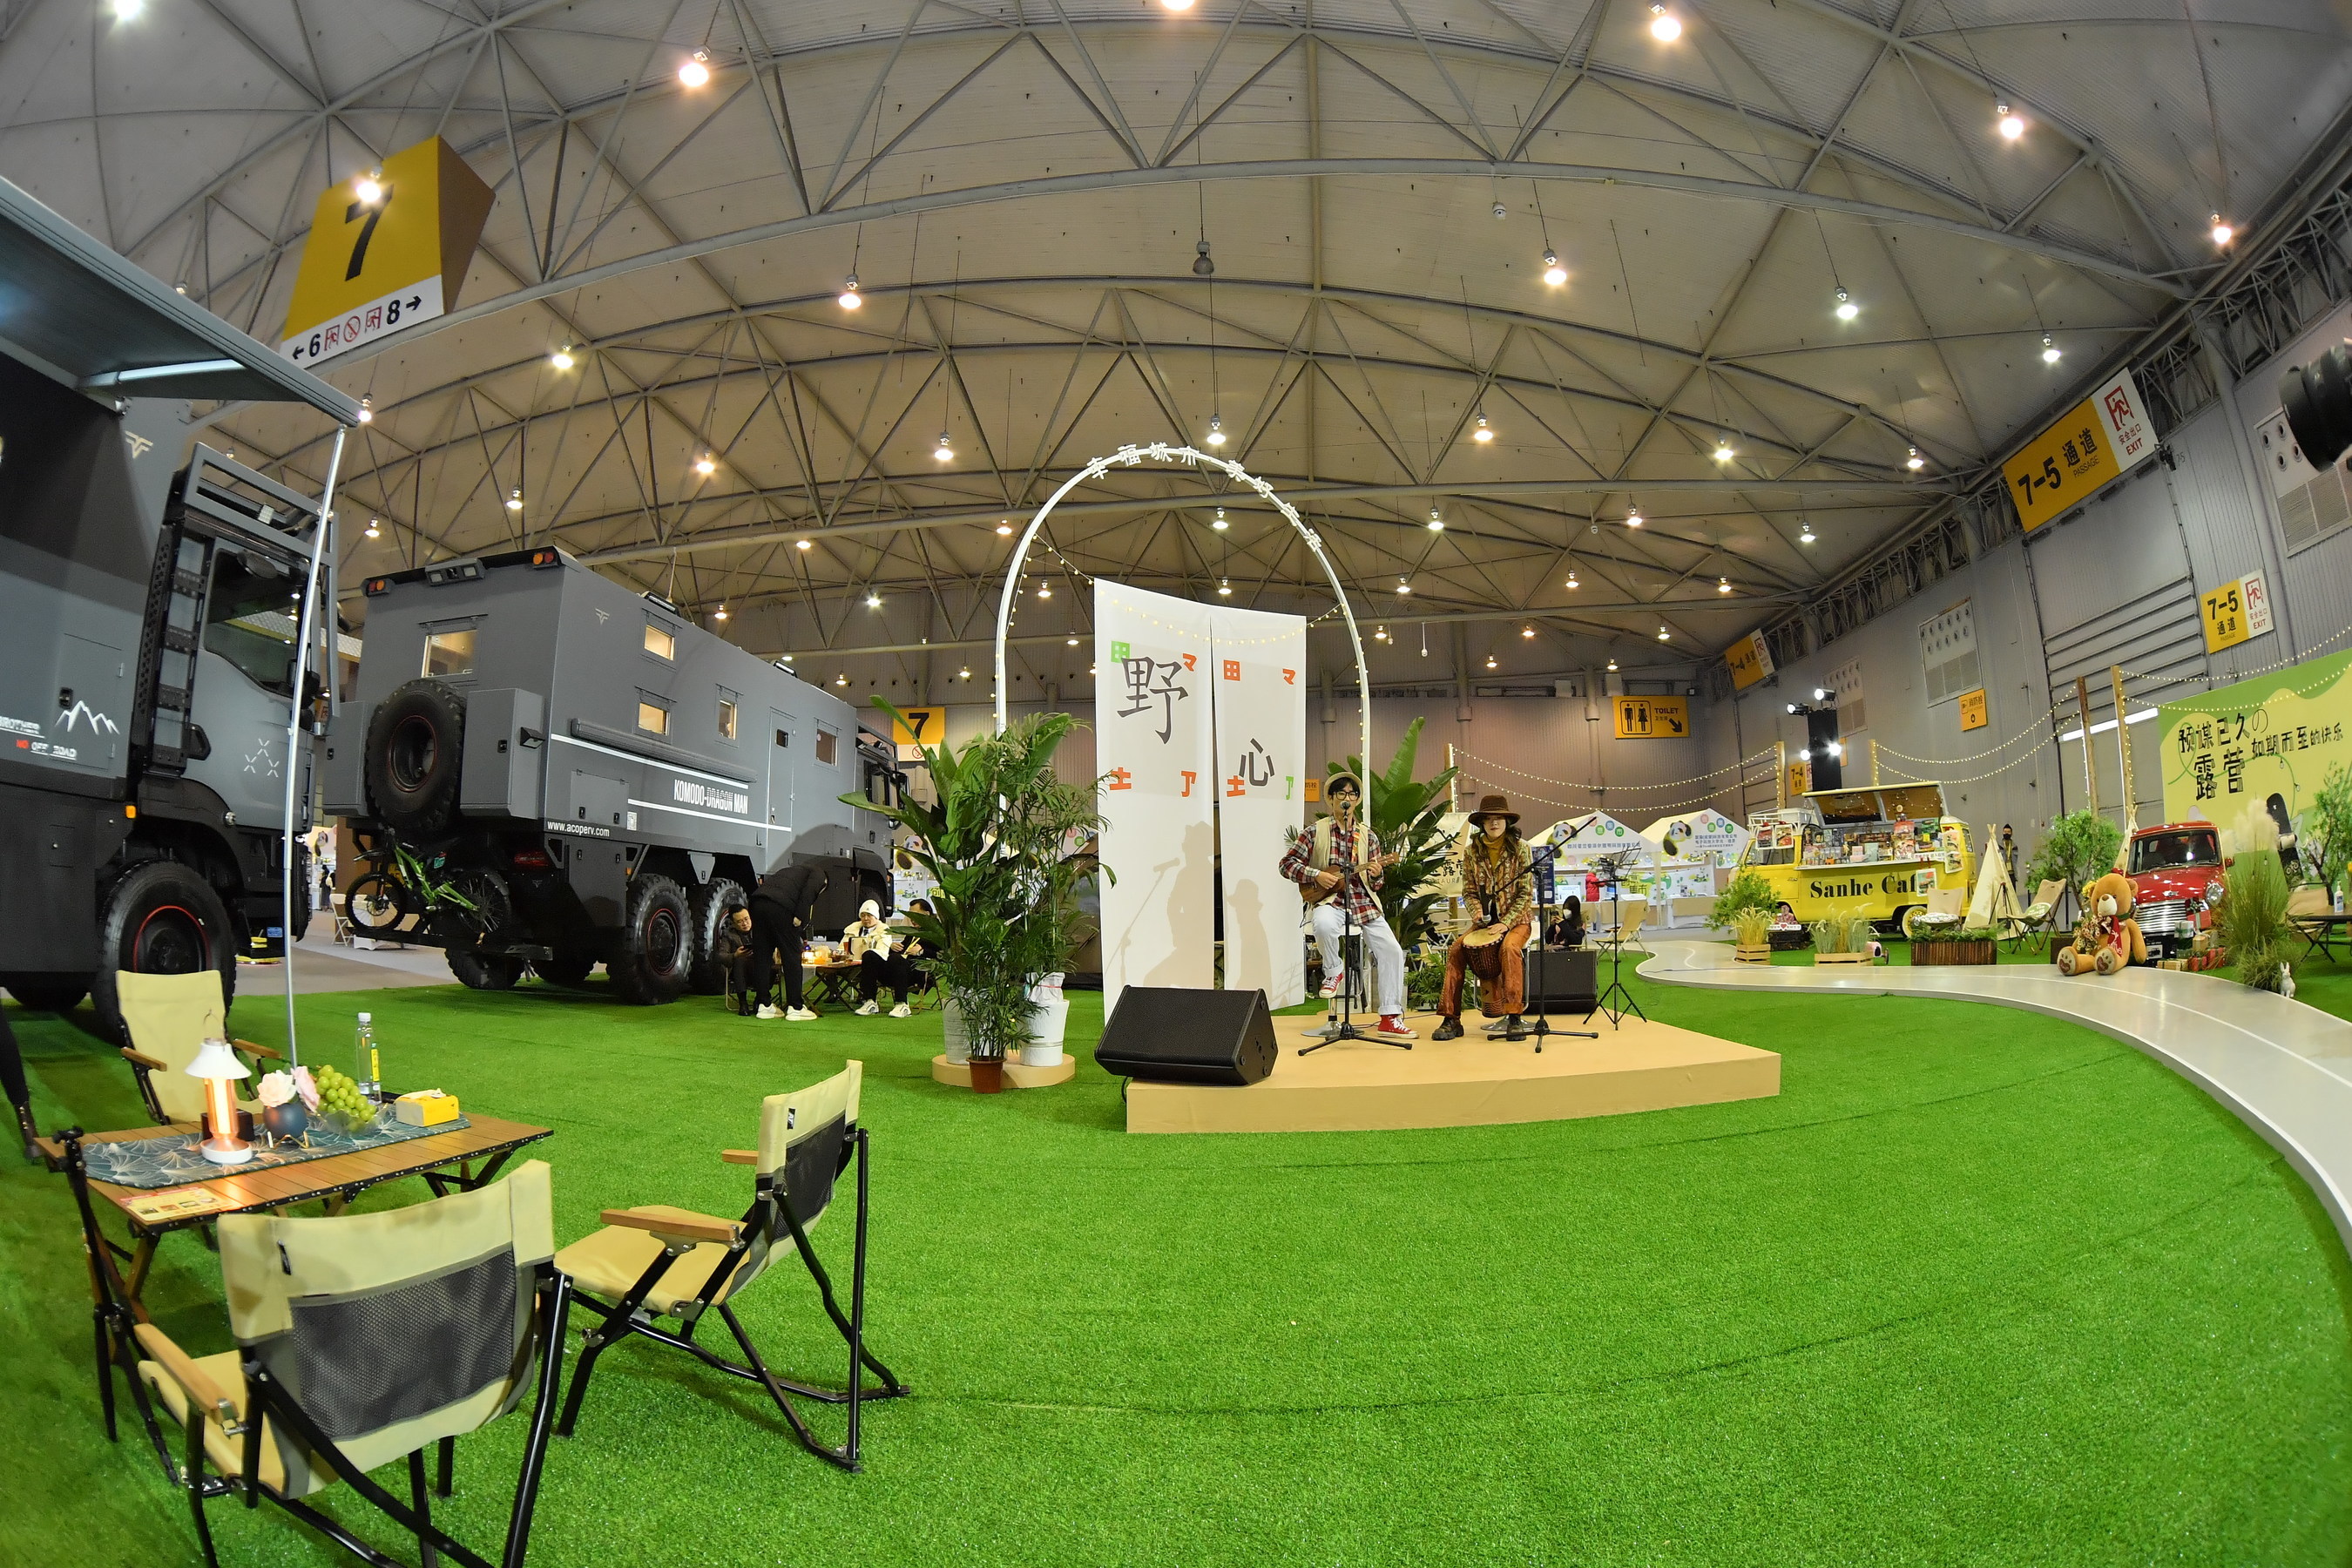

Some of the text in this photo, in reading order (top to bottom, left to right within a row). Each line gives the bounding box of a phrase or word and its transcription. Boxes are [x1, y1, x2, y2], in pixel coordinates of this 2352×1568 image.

[345, 184, 394, 281] 7
[308, 299, 401, 357] 6 8
[2119, 423, 2141, 445] 安全出口
[2126, 437, 2143, 456] EXIT
[2017, 427, 2098, 506] 7-5 通道
[2073, 455, 2099, 477] PASSAGE
[2207, 589, 2239, 620] 7-5
[2217, 617, 2236, 635] 通道
[2254, 618, 2266, 630] EXIT
[1117, 657, 1189, 745] 野
[908, 712, 929, 739] 7
[2251, 722, 2343, 760] 如期而至的快乐
[1239, 738, 1275, 787] 心
[2193, 747, 2246, 801] 露营
[673, 779, 748, 814] KOMODO-DRAGON MAN
[547, 821, 610, 837] www.acoperv.com
[1810, 873, 1916, 898] Sanhe Caf
